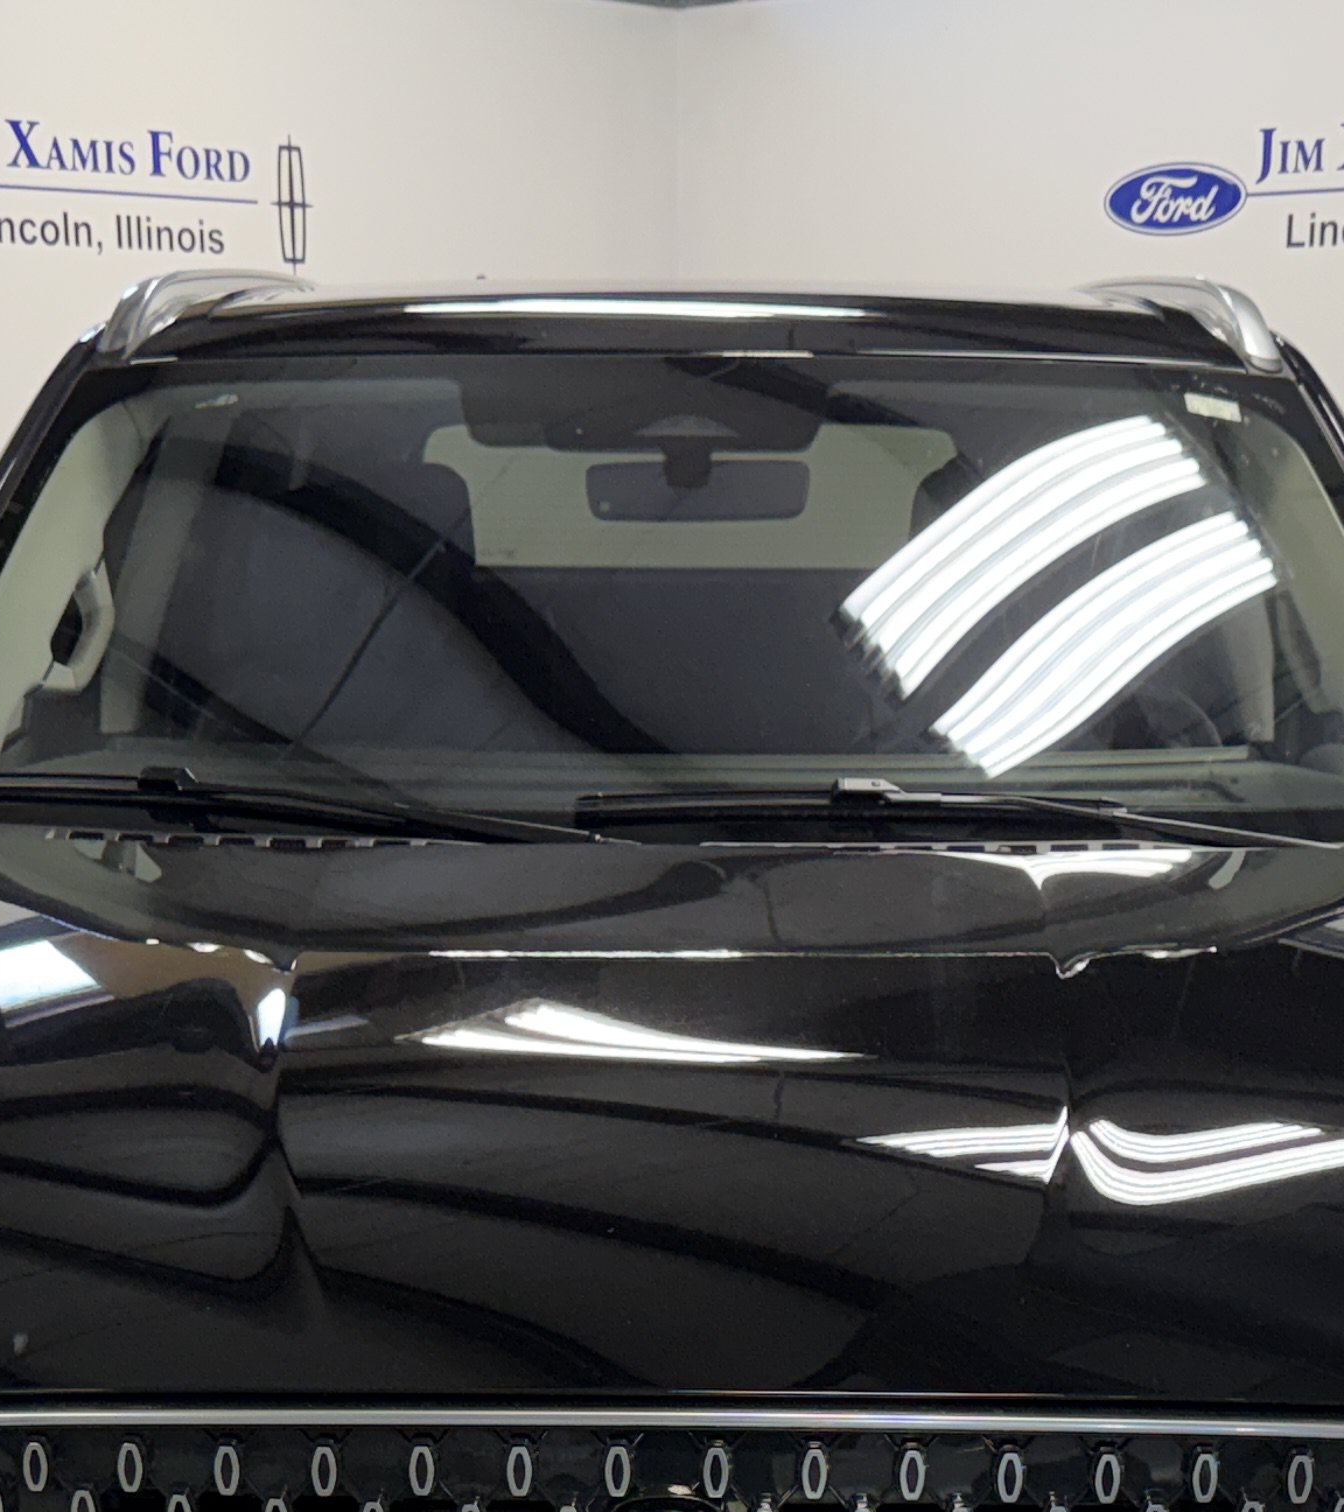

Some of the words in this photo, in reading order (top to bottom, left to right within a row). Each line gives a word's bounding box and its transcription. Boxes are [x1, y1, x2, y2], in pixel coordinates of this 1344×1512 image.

[4, 118, 136, 176] XAMIS
[147, 129, 251, 184] FORD
[1255, 127, 1325, 183] JIM
[1130, 175, 1217, 224] Ford
[115, 213, 226, 255] Illinois
